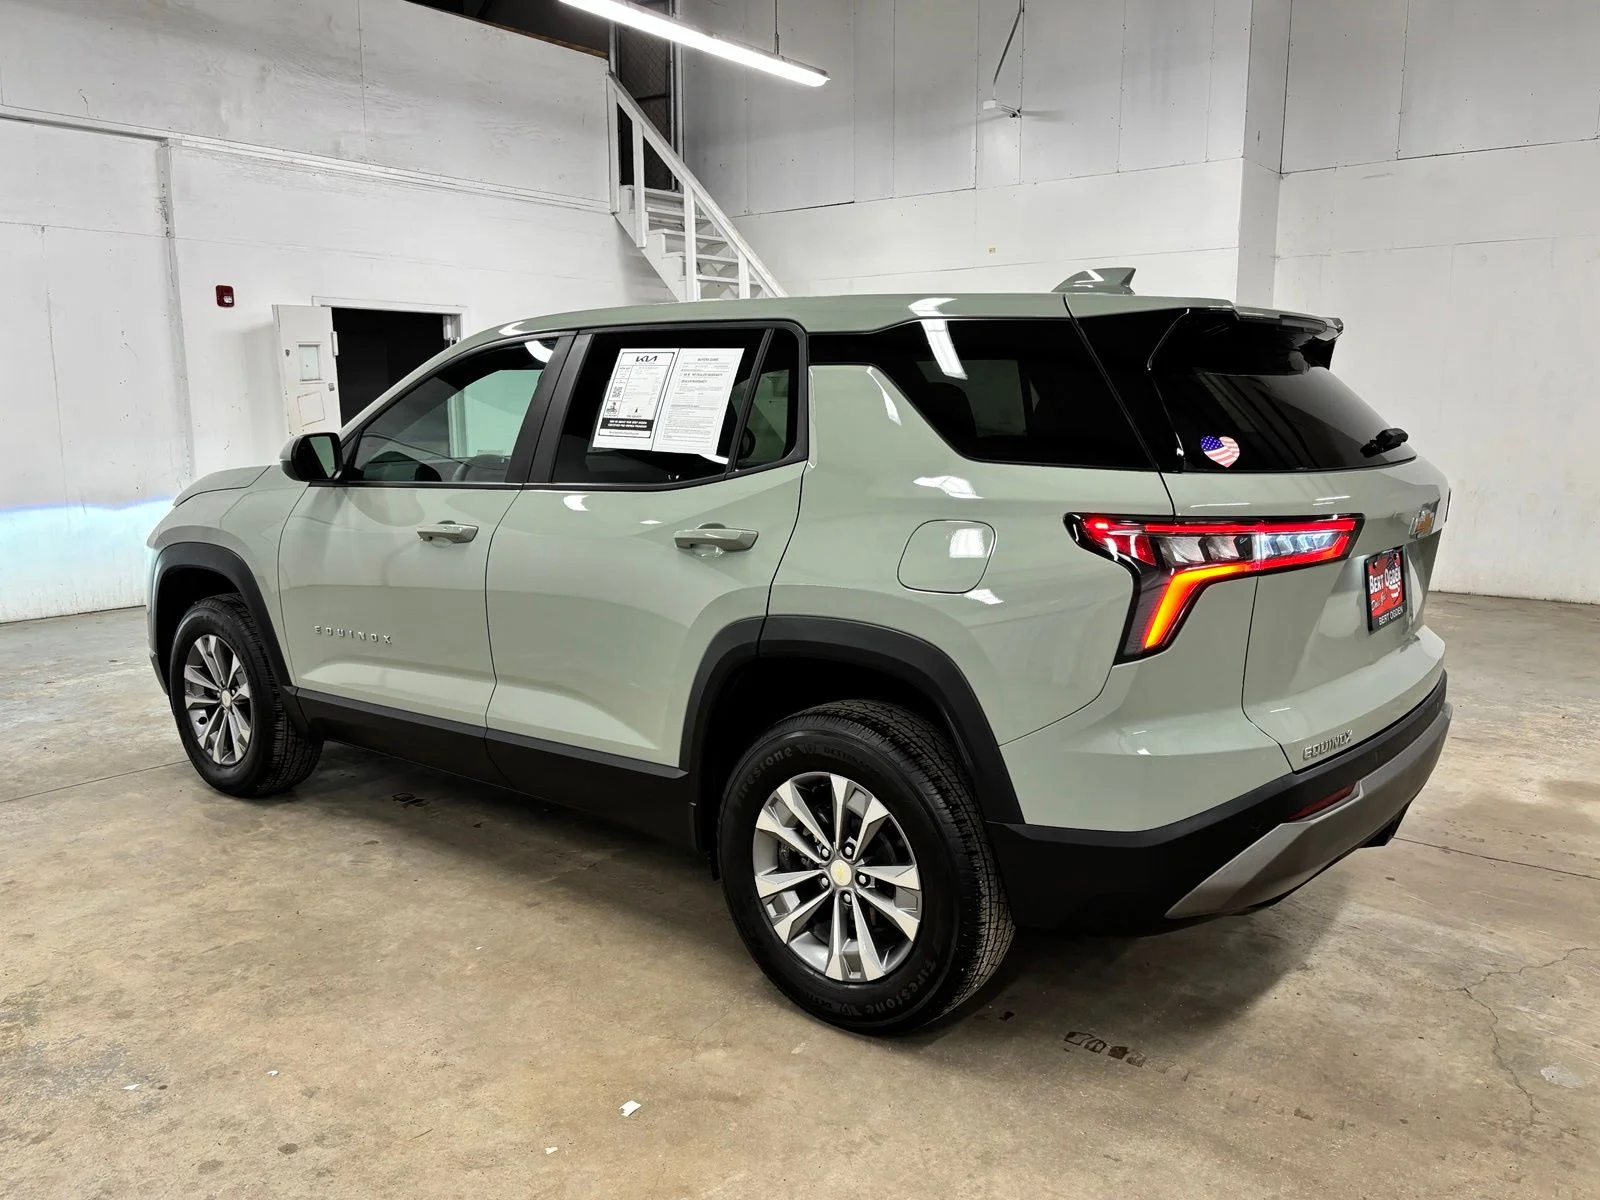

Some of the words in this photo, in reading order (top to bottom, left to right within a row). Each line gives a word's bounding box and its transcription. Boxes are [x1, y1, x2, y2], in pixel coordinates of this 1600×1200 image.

[1369, 574, 1384, 594] BERT
[1384, 566, 1402, 587] OGDEN
[1379, 614, 1390, 626] BERT
[1390, 607, 1404, 619] OGDEN
[314, 625, 392, 644] EQUINOX
[1303, 729, 1353, 760] EQUINOX
[864, 958, 937, 1016] Firestone
